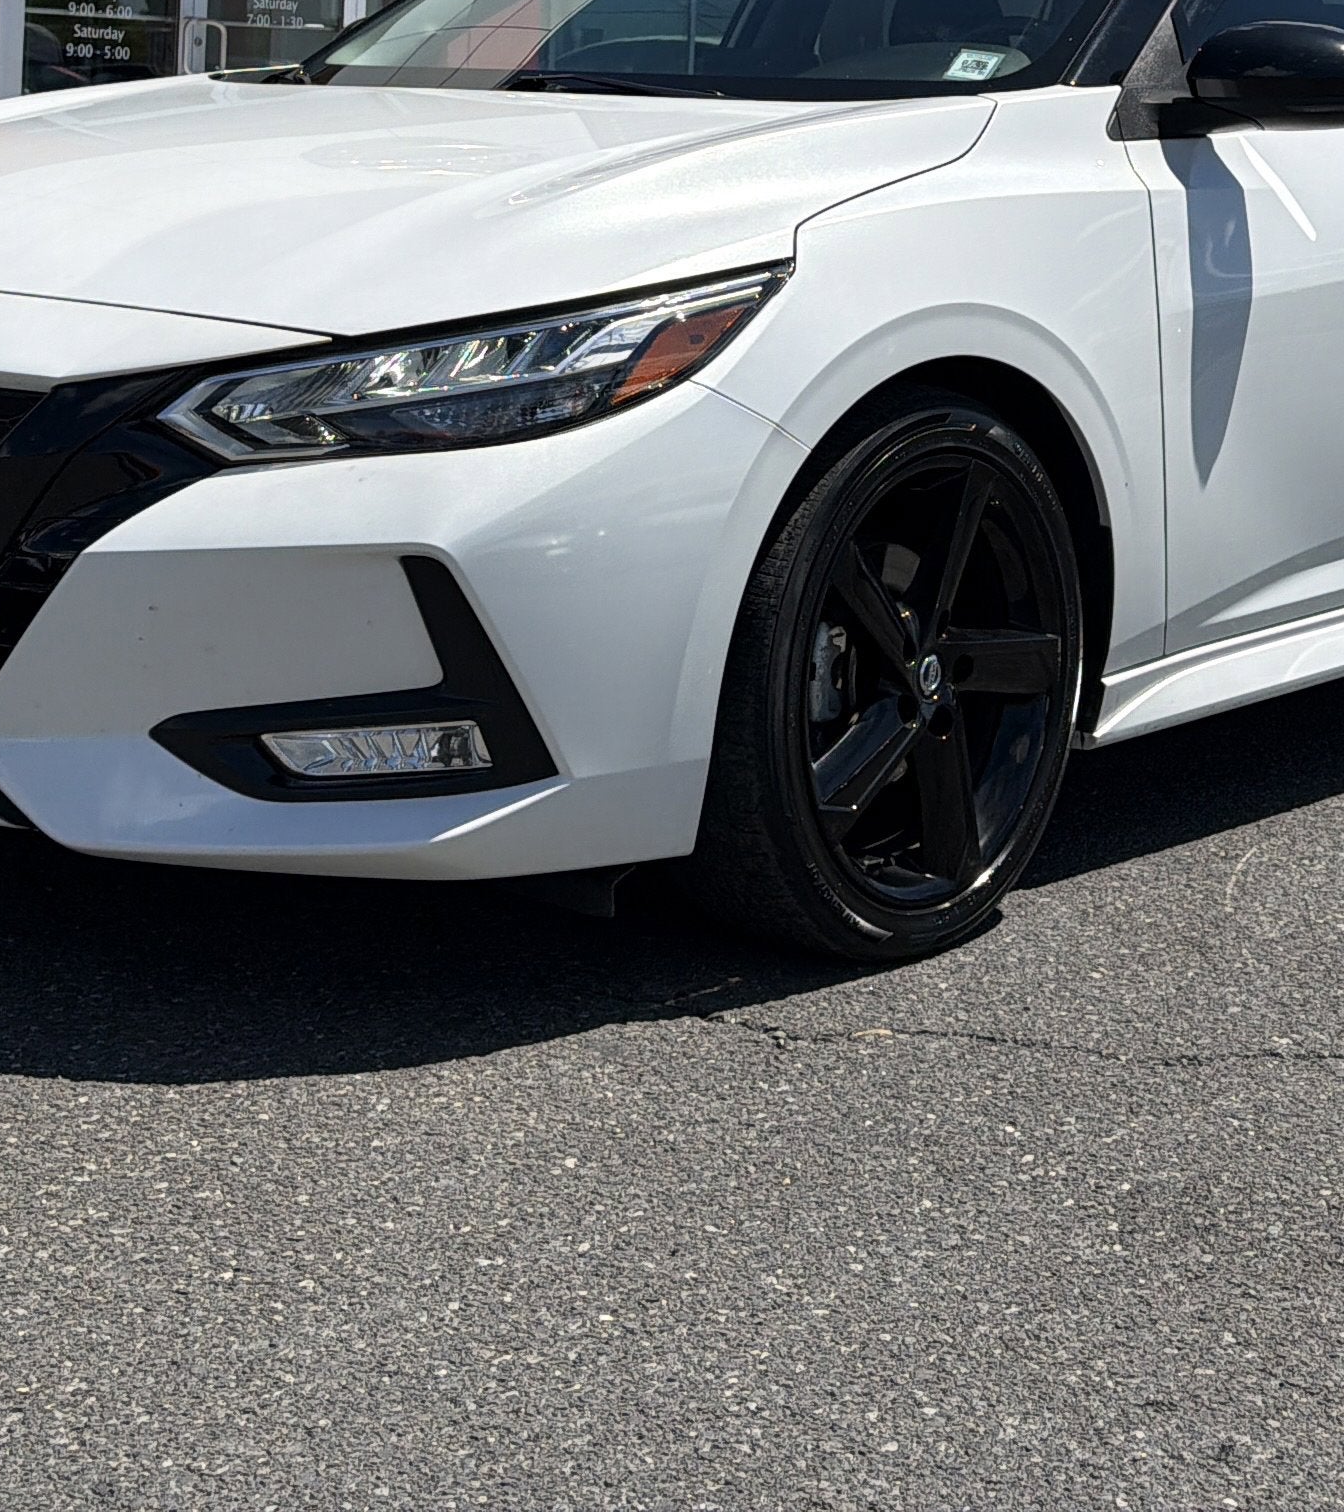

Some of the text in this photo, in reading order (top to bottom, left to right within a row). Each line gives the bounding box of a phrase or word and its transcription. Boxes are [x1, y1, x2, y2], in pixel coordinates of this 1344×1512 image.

[68, 2, 95, 17] 9:00
[105, 5, 132, 19] 6:00
[246, 13, 271, 27] 7:00
[280, 16, 304, 28] 1:30
[73, 23, 125, 43] Saturday
[66, 43, 93, 58] 9:00
[103, 46, 130, 61] 5:00
